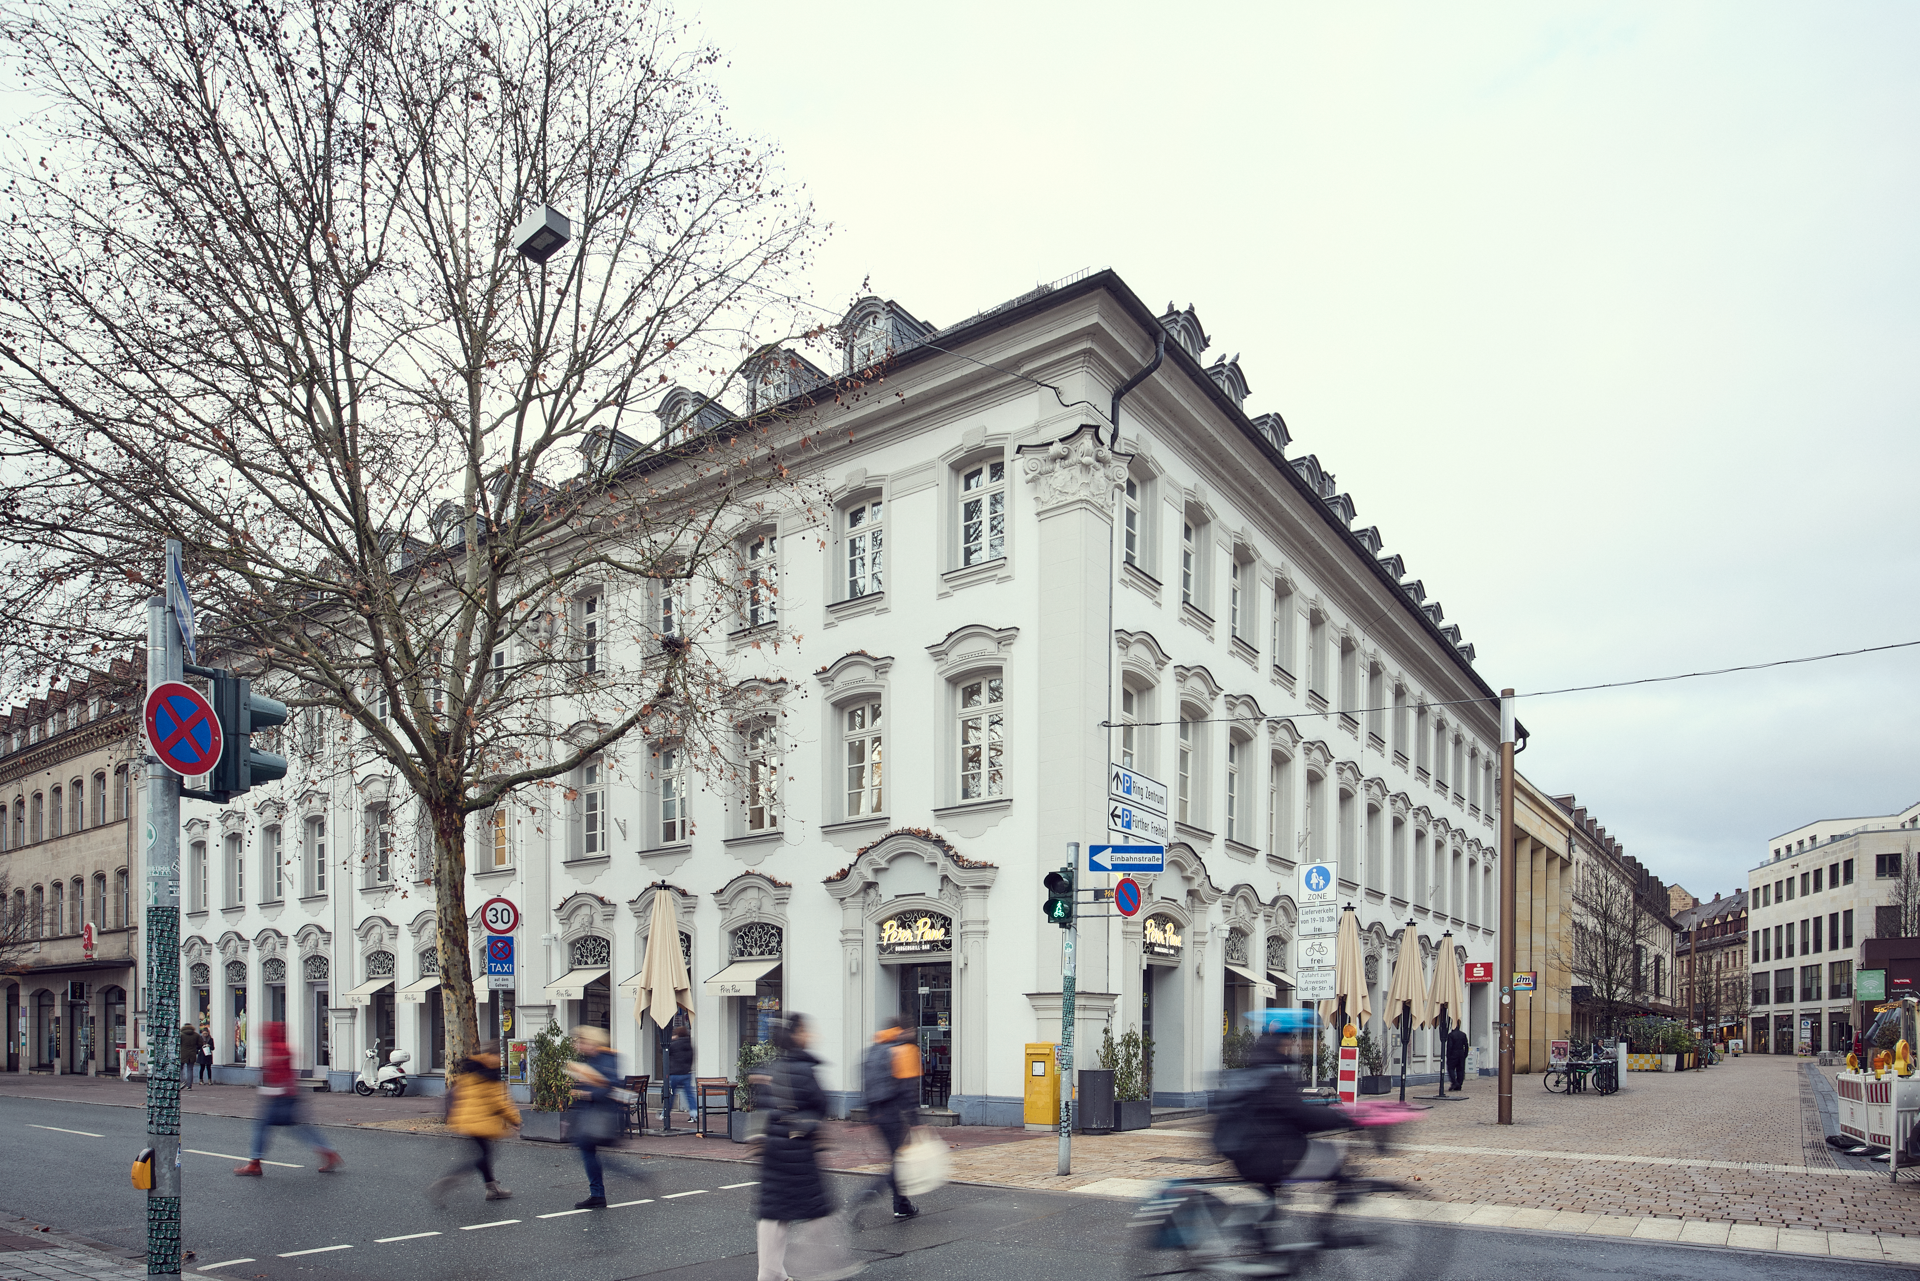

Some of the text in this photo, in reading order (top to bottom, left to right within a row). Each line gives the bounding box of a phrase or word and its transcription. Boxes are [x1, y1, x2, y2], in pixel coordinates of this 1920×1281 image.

[1124, 774, 1165, 806] P Ring Zentrum
[1123, 810, 1167, 839] P Fürther Freiheit
[1110, 855, 1161, 863] Einbahnstraße
[1307, 893, 1327, 901] ZONE
[488, 907, 511, 925] 30
[1301, 907, 1334, 915] Lieferverkehr
[881, 918, 945, 946] Peter Pane
[1165, 922, 1182, 947] Pane
[1310, 957, 1324, 965] frei
[489, 963, 513, 973] TAXI
[1516, 975, 1531, 983] dm
